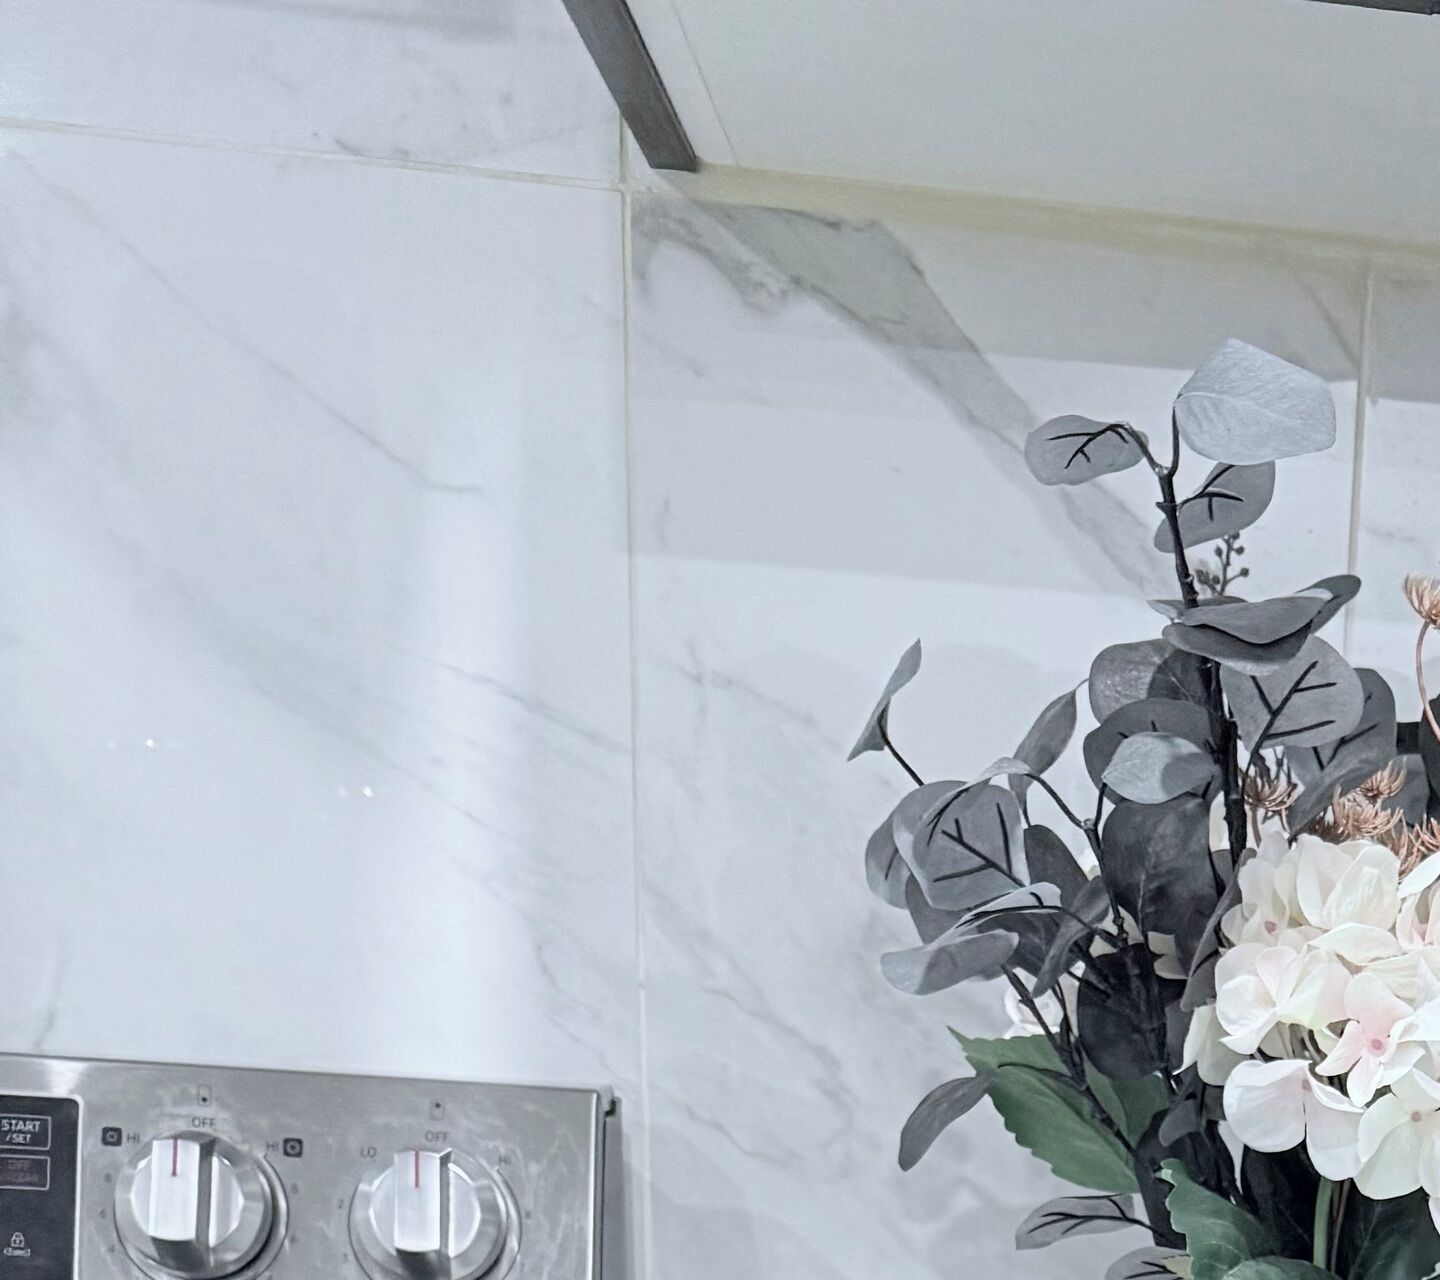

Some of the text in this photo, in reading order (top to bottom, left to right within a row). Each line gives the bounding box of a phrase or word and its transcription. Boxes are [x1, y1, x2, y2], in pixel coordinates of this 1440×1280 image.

[1, 1119, 41, 1132] START
[191, 1117, 216, 1128] OFF
[126, 1132, 140, 1143] HI
[425, 1131, 450, 1142] OFF
[360, 1147, 377, 1158] LO
